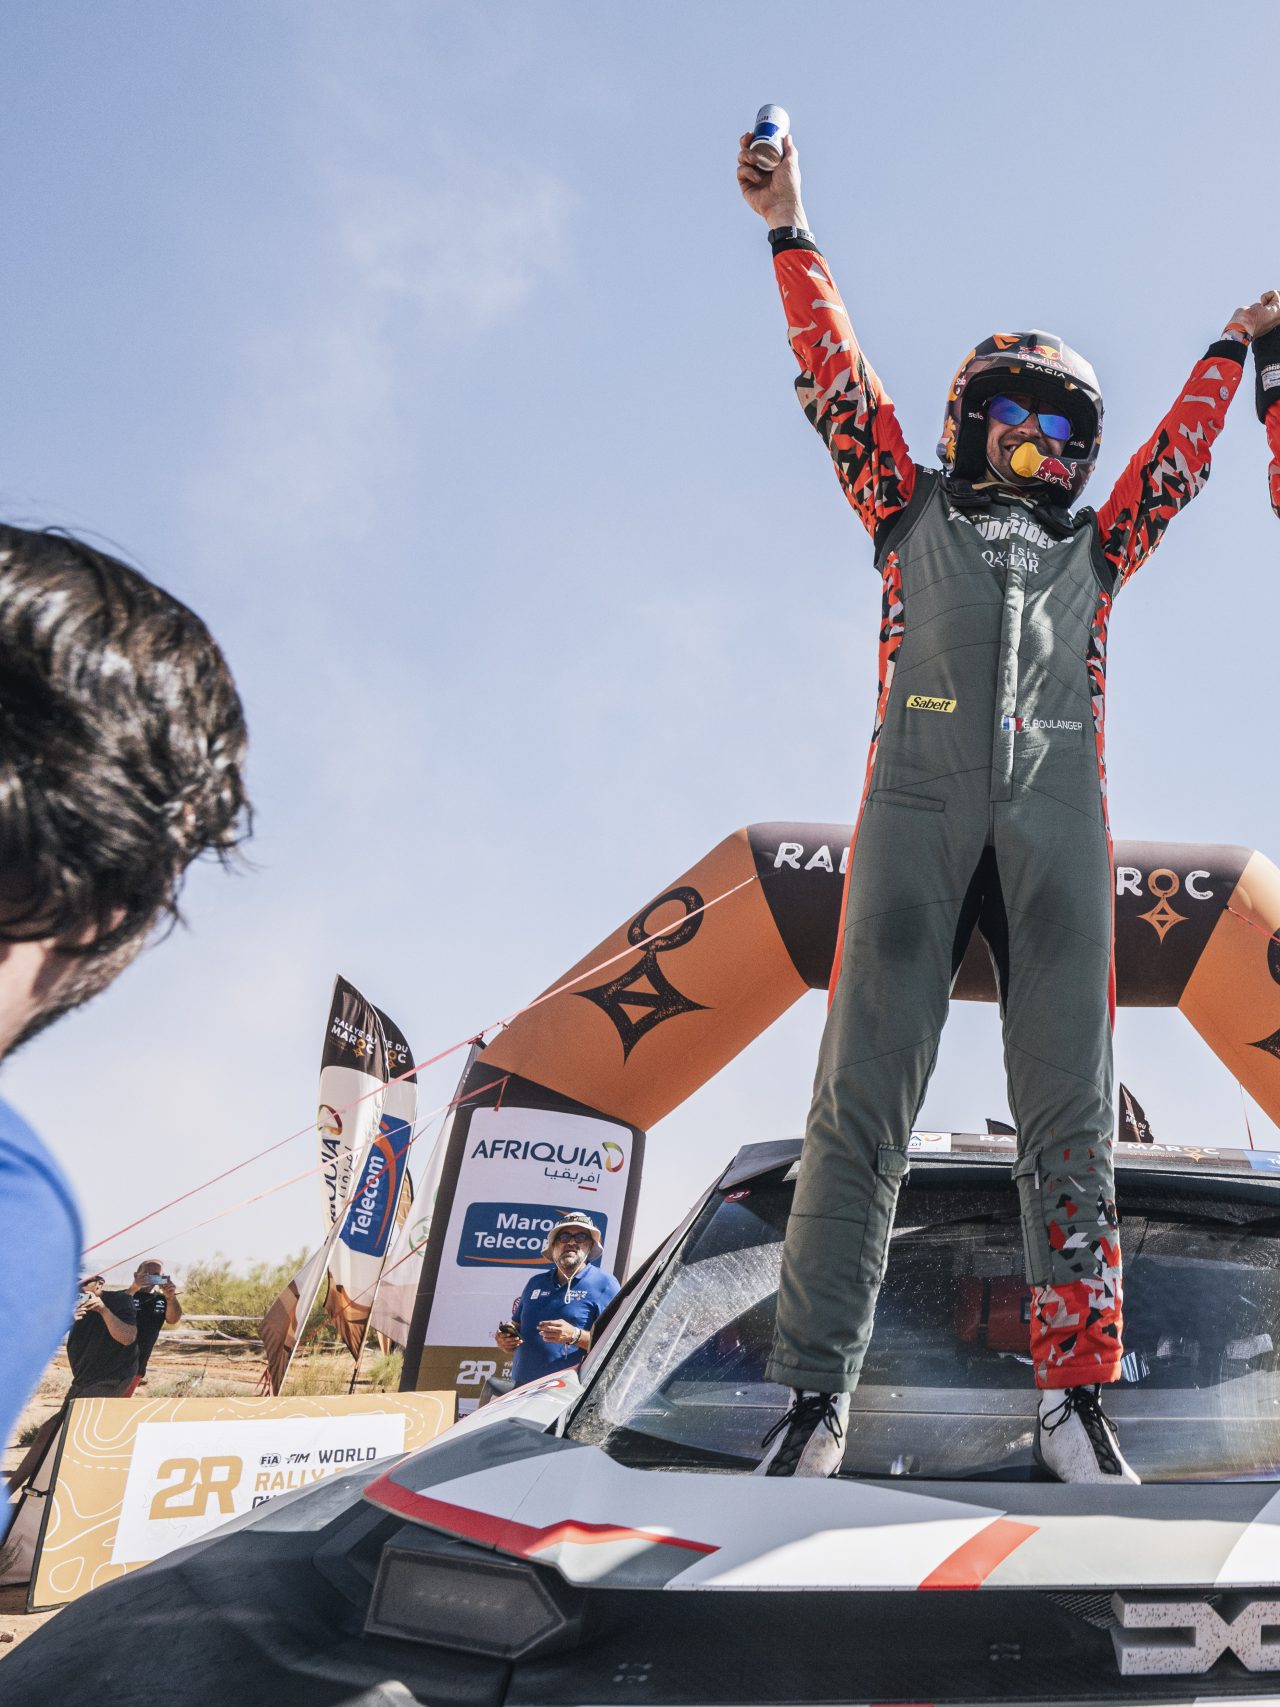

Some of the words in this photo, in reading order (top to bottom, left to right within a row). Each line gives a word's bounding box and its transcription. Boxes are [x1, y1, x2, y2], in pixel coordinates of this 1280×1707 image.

[1025, 362, 1066, 379] DACIA
[909, 695, 951, 711] Sabelt
[1032, 719, 1083, 732] BOULANGER
[331, 1024, 375, 1056] MAROC
[334, 1016, 365, 1038] RALLYE
[365, 1033, 378, 1045] DU
[395, 1043, 409, 1053] DU
[471, 1139, 603, 1170] AFRIQUIA
[1127, 1143, 1220, 1157] MAROC
[350, 1155, 385, 1236] Telecom
[496, 1212, 560, 1231] Maro
[456, 1360, 497, 1385] 2R
[318, 1446, 377, 1464] WORLD
[149, 1456, 243, 1520] 2R
